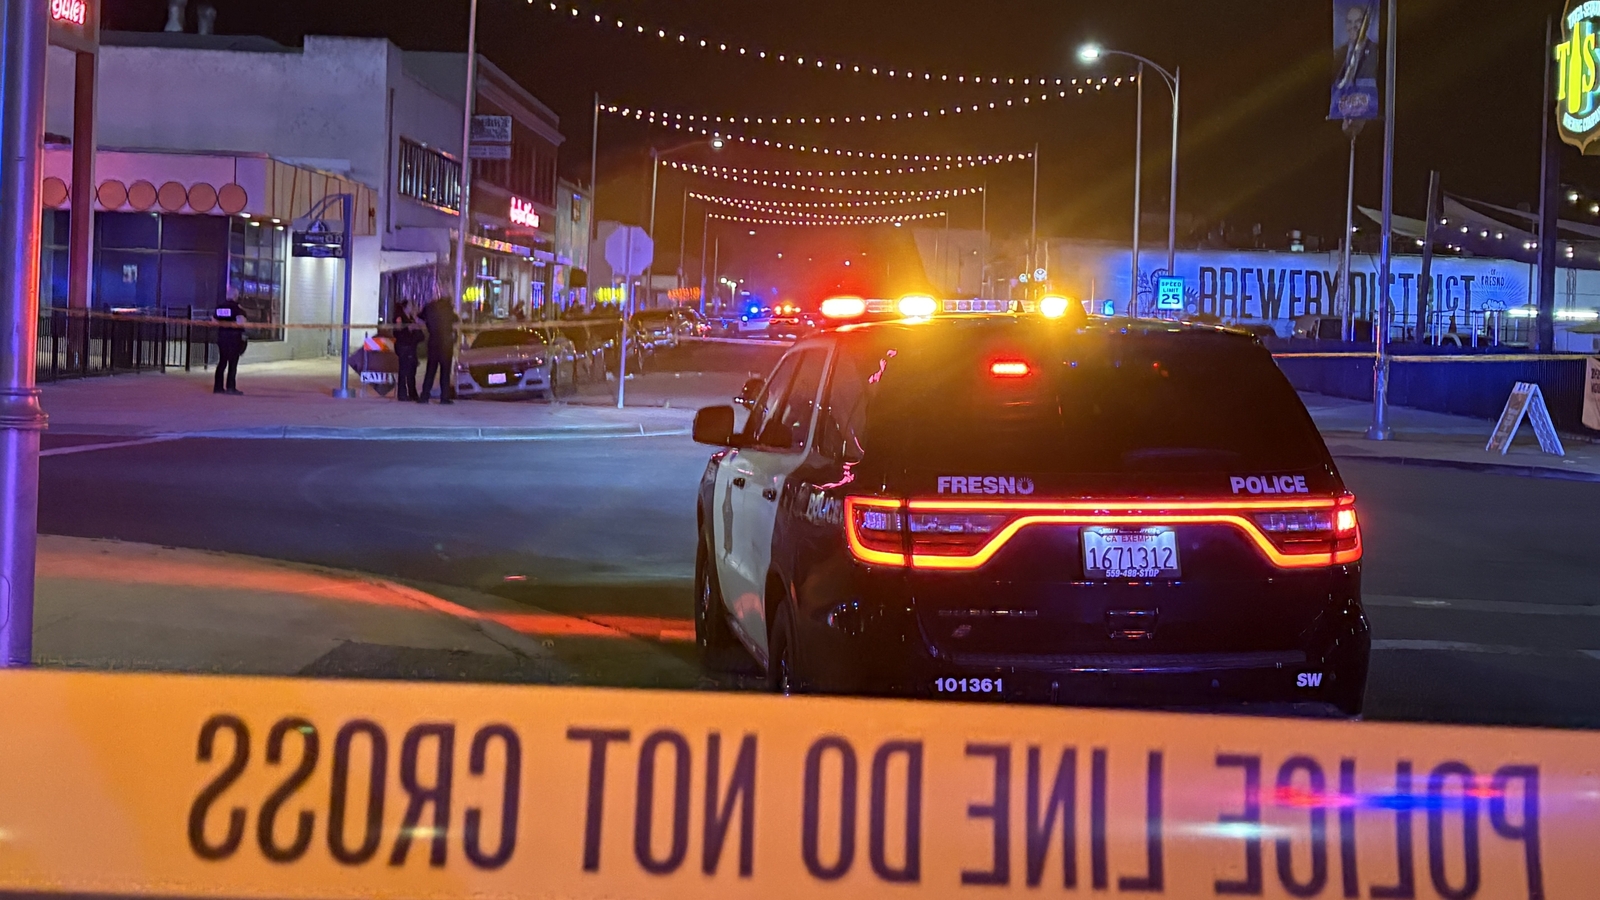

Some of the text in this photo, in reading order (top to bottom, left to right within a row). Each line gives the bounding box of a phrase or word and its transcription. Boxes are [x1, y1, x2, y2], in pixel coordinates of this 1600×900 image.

[1481, 275, 1505, 287] FRESNO
[1161, 293, 1180, 305] 25
[1199, 265, 1342, 319] BREWERY
[937, 475, 1309, 495] FRESNO POLICE
[1105, 534, 1155, 543] CA EXEMPT
[1089, 546, 1175, 570] 1671312
[1105, 568, 1160, 578] 559-498-STOP
[934, 677, 1003, 693] 101361
[1296, 672, 1323, 687] SW
